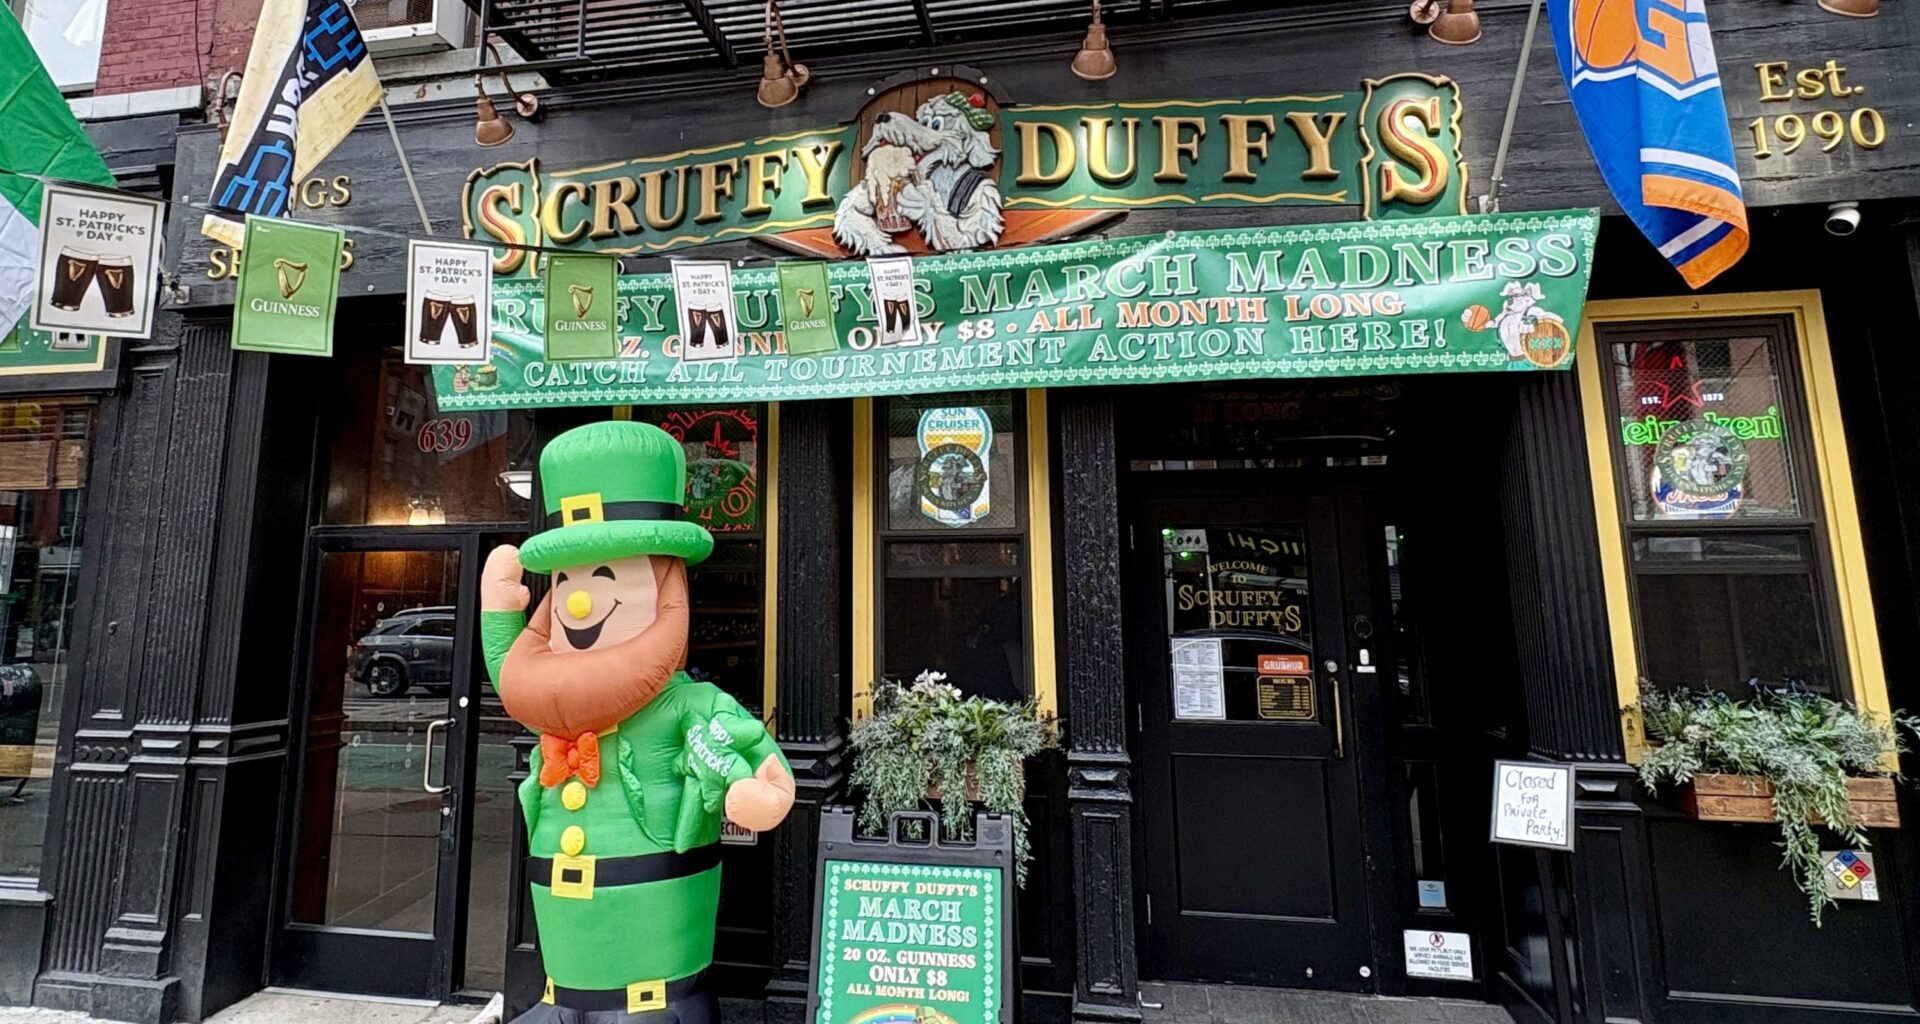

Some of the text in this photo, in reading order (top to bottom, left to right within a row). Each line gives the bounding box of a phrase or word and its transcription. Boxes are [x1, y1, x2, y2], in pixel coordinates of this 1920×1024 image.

[1754, 60, 1865, 102] Est.
[1748, 107, 1886, 158] 1990
[79, 208, 125, 222] HAPPY
[476, 140, 842, 274] SCRUFFY
[56, 216, 146, 235] ST. PATRICK'S
[86, 230, 113, 241] DAY
[419, 265, 482, 277] ST. PATRICK'S
[435, 257, 468, 267] HAPPY
[441, 275, 461, 284] DAY
[690, 273, 712, 281] HAPPY
[959, 252, 1199, 314] MARCH
[1226, 233, 1579, 294] MADNESS
[251, 298, 320, 318] GUINNESS
[957, 318, 996, 342] $8
[1026, 303, 1103, 333] ALL
[1116, 296, 1268, 328] MONTH
[1283, 290, 1405, 322] LONG
[555, 320, 607, 332] GUINNESS
[789, 319, 827, 331] GUINNESS
[524, 361, 649, 387] CATCH
[664, 360, 746, 383] ALL
[764, 336, 1067, 382] TOURNEMENT
[1087, 327, 1267, 362] ACTION
[1289, 318, 1447, 354] HERE!
[1641, 396, 1661, 404] EST.
[941, 407, 967, 416] SUN
[928, 420, 980, 429] CRUISER
[417, 418, 472, 453] 639
[1207, 560, 1270, 575] WELCOME
[1178, 584, 1283, 611] SCRUFFY
[1263, 660, 1304, 670] GRUBHUB
[1505, 769, 1557, 790] Closed
[843, 879, 978, 897] SCRUFFY DUFFY'S
[858, 896, 962, 922] MARCH
[842, 919, 978, 948] MADNESS
[843, 948, 976, 969] 20 OZ. GUINNESS
[869, 965, 948, 986] ONLY $8
[847, 983, 970, 1002] ALL MONTH LONG!
